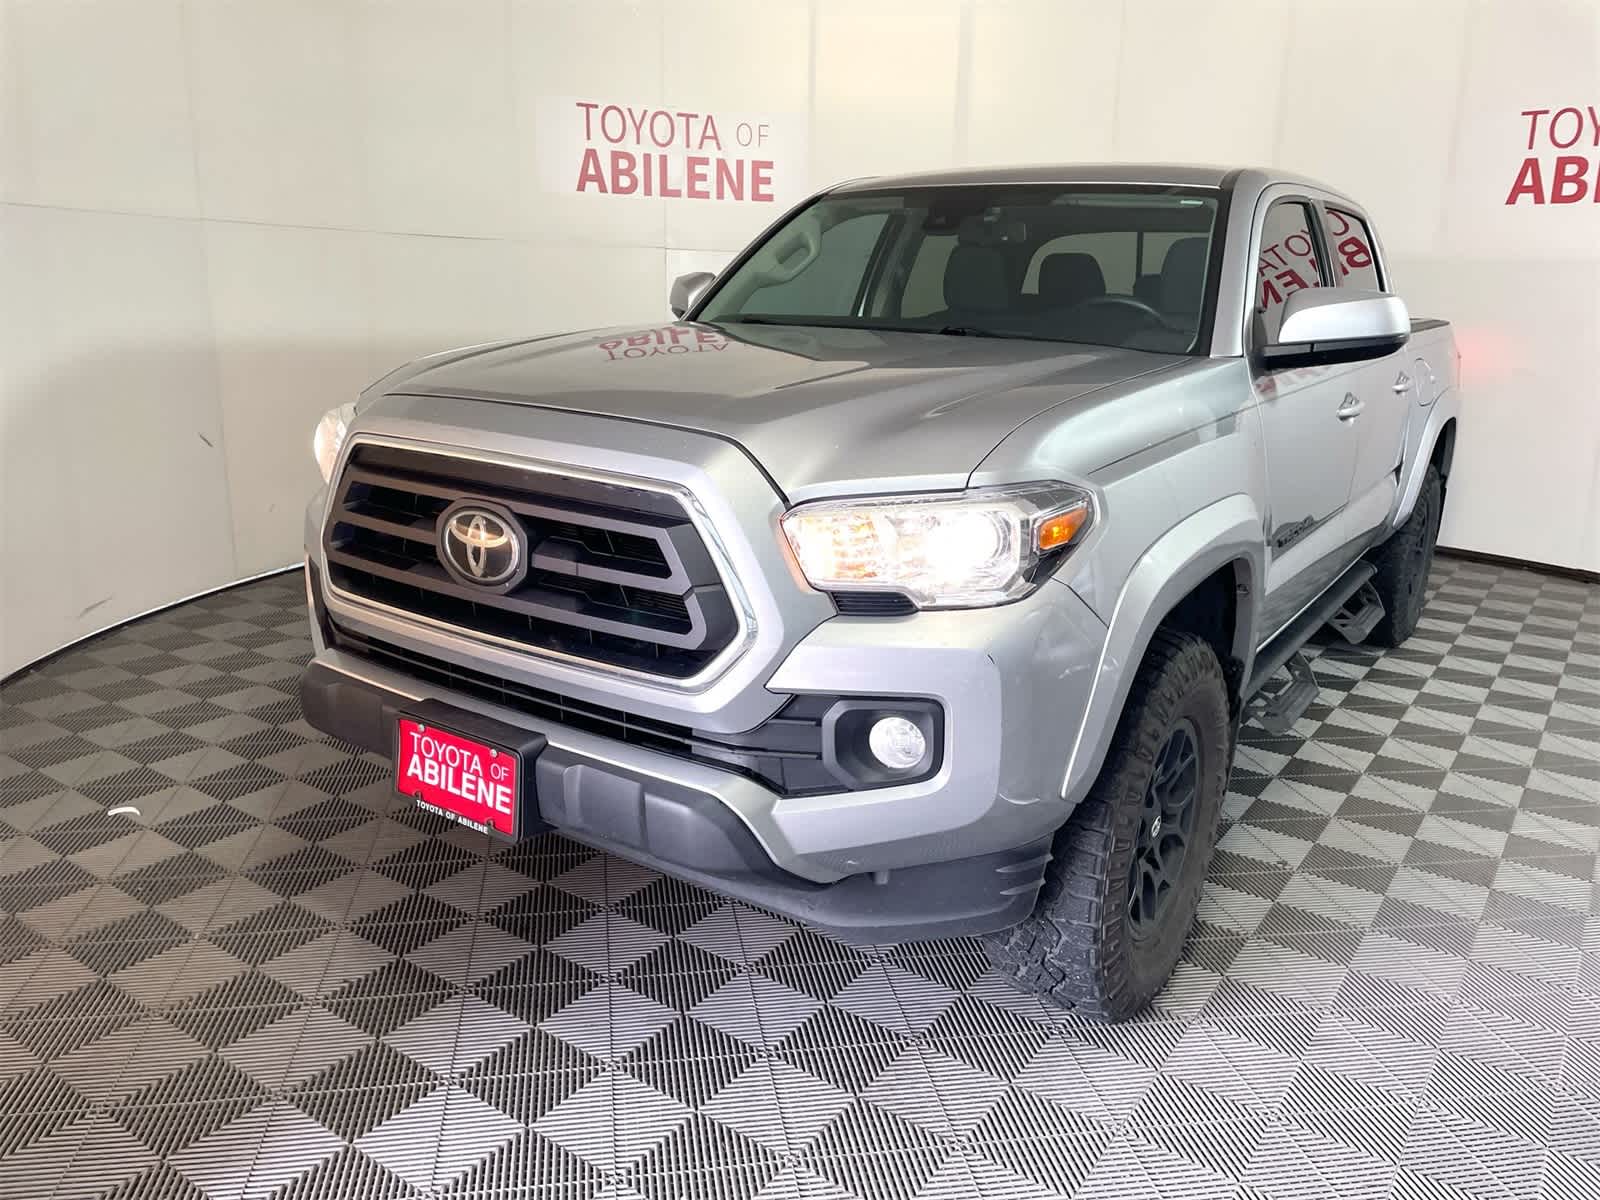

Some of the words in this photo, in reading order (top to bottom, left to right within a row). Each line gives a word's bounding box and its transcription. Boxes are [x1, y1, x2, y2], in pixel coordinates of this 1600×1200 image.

[576, 102, 722, 150] TOYOTA
[736, 122, 769, 147] OF
[576, 148, 774, 202] ABILENE
[410, 731, 483, 777] TOYOTA
[490, 763, 509, 782] OF
[407, 754, 511, 815] ABILENE
[416, 799, 444, 817] TOYOTA
[445, 811, 456, 822] OF
[457, 815, 489, 835] ABILENE
